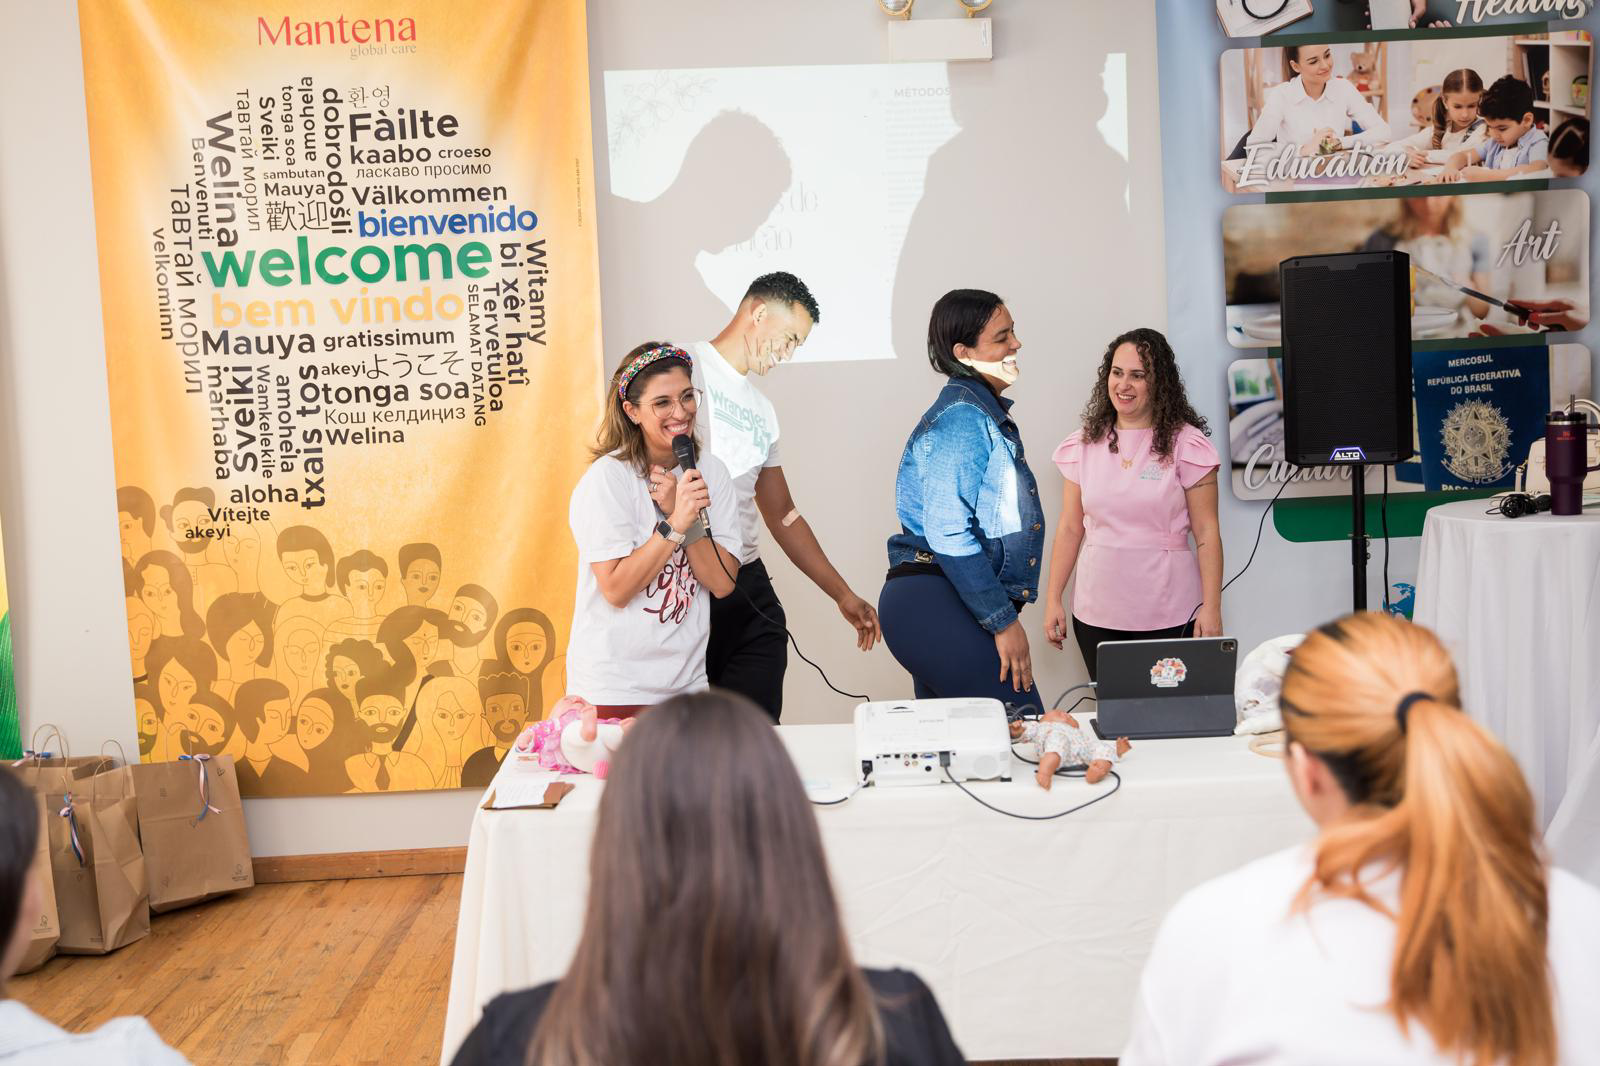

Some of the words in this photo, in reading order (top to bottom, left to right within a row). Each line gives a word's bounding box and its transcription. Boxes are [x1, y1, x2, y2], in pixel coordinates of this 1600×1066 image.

[258, 14, 416, 46] Mantena
[350, 44, 387, 60] global
[392, 45, 416, 54] care
[281, 86, 294, 132] tonga
[298, 76, 316, 162] amohela
[349, 108, 459, 142] Fàilte
[259, 97, 279, 160] Sveiki
[285, 138, 296, 166] soa
[322, 88, 352, 234] dobrodošli
[350, 144, 432, 164] kaabo
[438, 148, 492, 158] croeso
[1236, 141, 1411, 189] Education
[206, 110, 242, 247] Welina
[263, 170, 324, 180] sambutan
[356, 166, 420, 178] ласкаво
[424, 164, 492, 178] просимо
[192, 138, 214, 240] Benvenuti
[264, 182, 326, 198] Mauya
[352, 186, 507, 206] Välkommen
[266, 200, 330, 232] 歡迎
[358, 204, 538, 238] bienvenido
[500, 242, 524, 268] bi
[1496, 219, 1563, 268] Art
[201, 236, 492, 288] welcome
[153, 228, 174, 340] velkominn
[502, 278, 526, 323] xêr
[526, 239, 548, 346] Witamy
[211, 293, 316, 328] bem
[330, 287, 465, 325] vindo
[468, 284, 482, 356] SELAMAT
[202, 330, 316, 360] Mauya
[323, 329, 454, 352] gratissimum
[483, 282, 506, 412] Tervetuloa
[321, 361, 366, 377] akeyi
[366, 350, 464, 379] ようこそ
[506, 332, 530, 386] hatî
[1448, 354, 1494, 368] MERCOSUL
[296, 364, 320, 418] tos
[471, 362, 486, 426] DATANG
[1427, 375, 1468, 386] REPÚBLICA
[1470, 368, 1521, 382] FEDERATIVA
[1450, 386, 1462, 395] DO
[1464, 384, 1494, 394] BRASIL
[322, 383, 409, 407] tonga
[420, 382, 470, 400] soa
[708, 385, 767, 431] Wrangler
[206, 366, 232, 480] marhaba
[223, 366, 258, 472] Sveiki
[256, 364, 276, 479] Wamkelekile
[276, 375, 298, 473] amohela
[325, 409, 366, 424] Кош
[372, 407, 466, 424] келдиңиз
[326, 426, 404, 446] Welina
[296, 428, 326, 510] txais
[230, 484, 298, 503] aloha
[185, 524, 230, 540] akeyi
[208, 507, 270, 524] Vítejte
